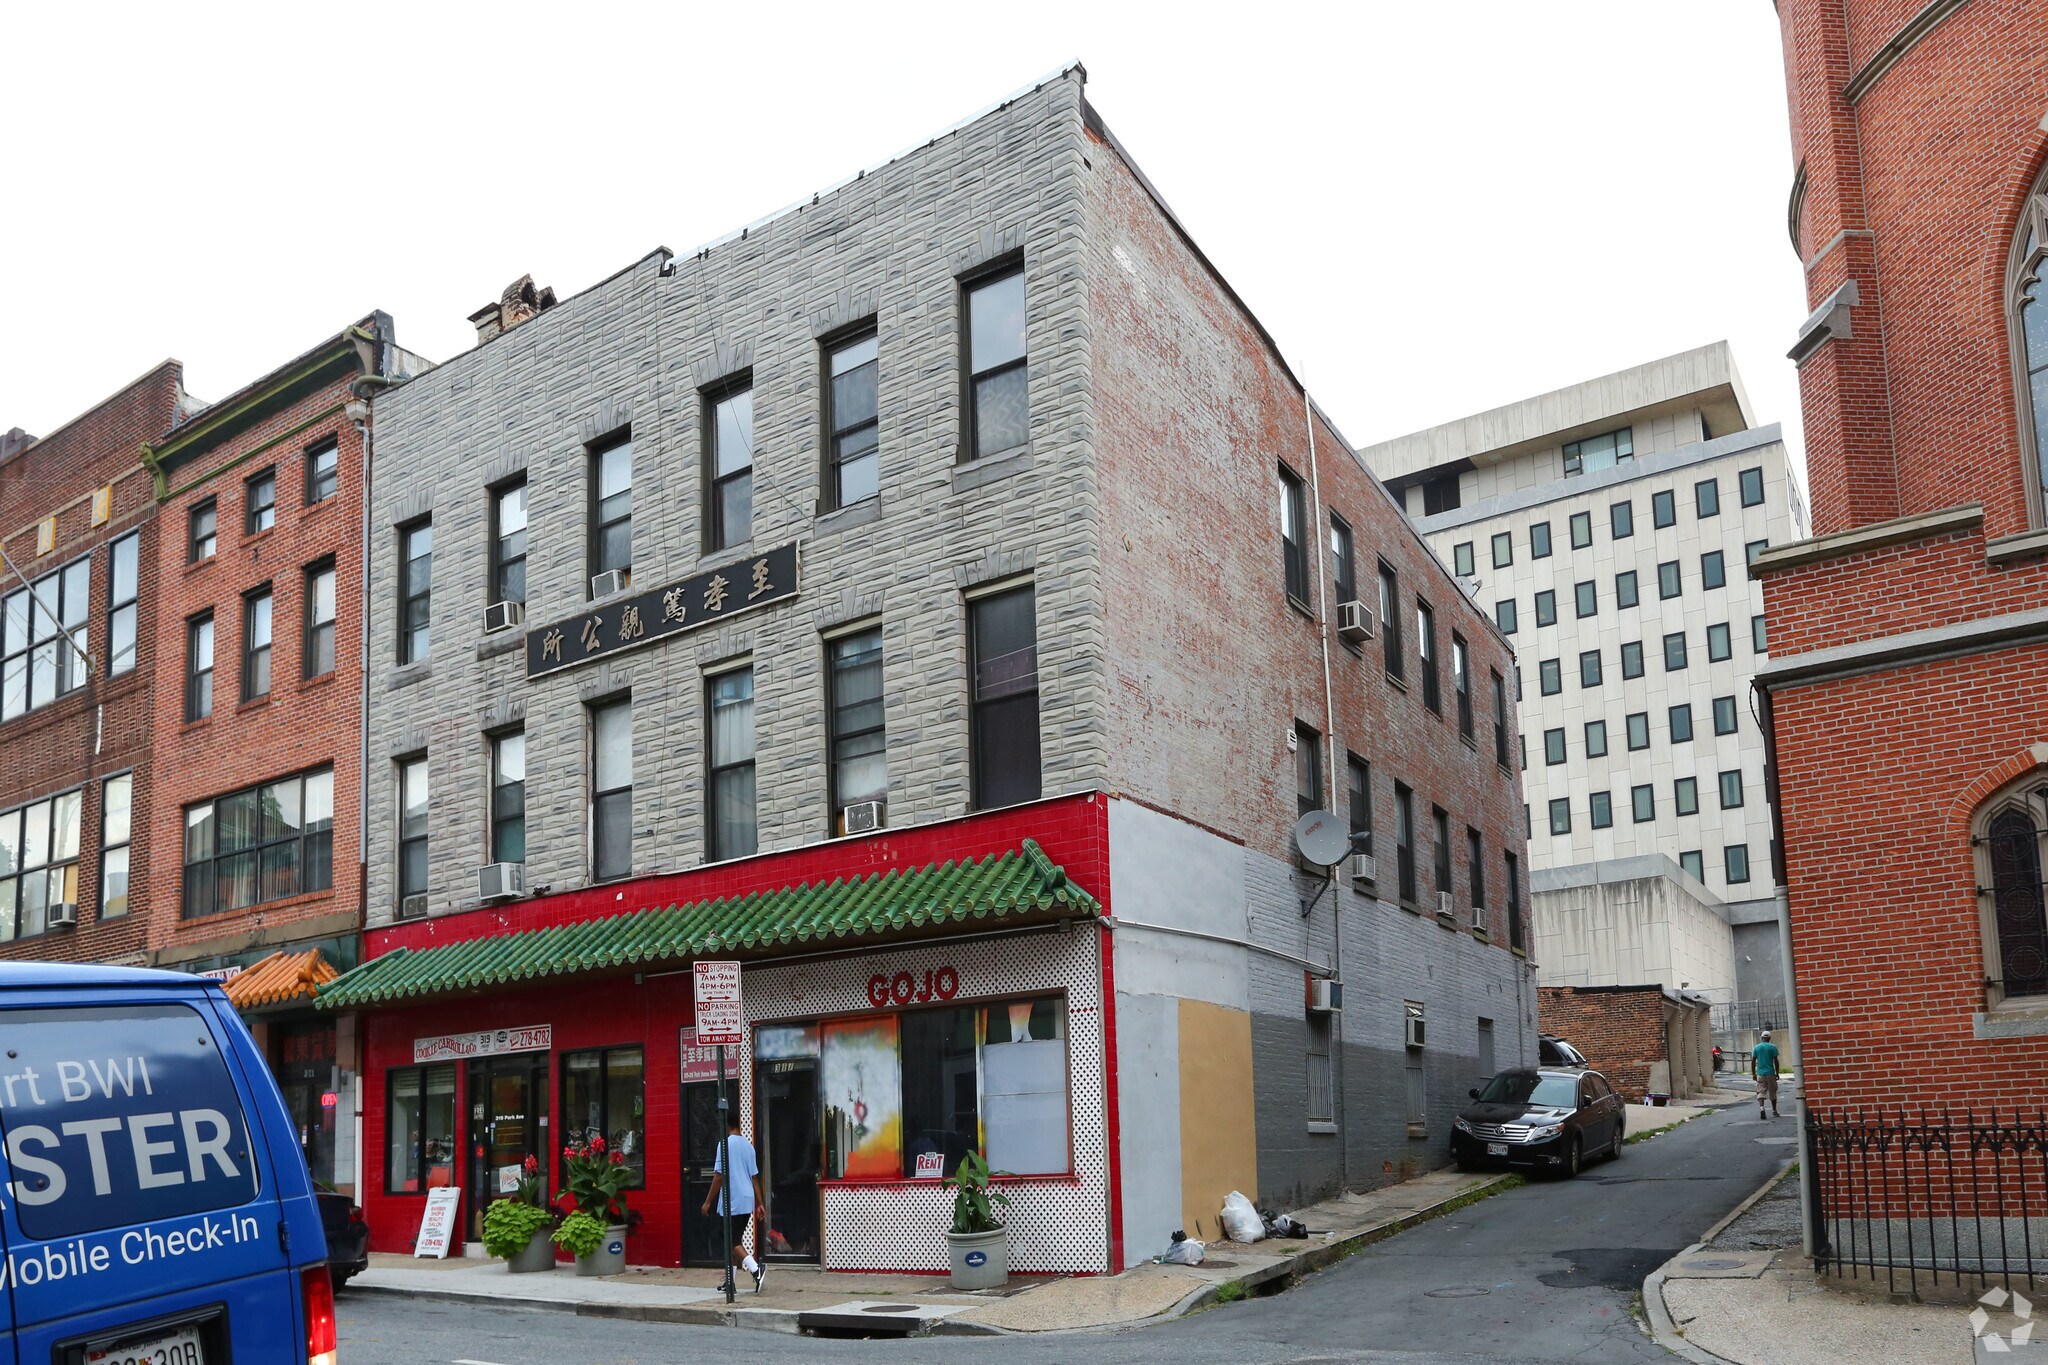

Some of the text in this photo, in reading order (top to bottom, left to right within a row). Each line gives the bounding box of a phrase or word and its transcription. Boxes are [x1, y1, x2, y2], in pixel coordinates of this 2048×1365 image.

[696, 964, 737, 973] NO STOPPING
[699, 973, 736, 981] 7AM-9AM
[699, 982, 737, 990] 4PM-6PM
[867, 965, 959, 1008] GOJO
[697, 1003, 710, 1011] NO
[701, 1018, 738, 1026] 9AM-4PM
[480, 1034, 491, 1044] 319
[520, 1029, 550, 1047] 278-4782
[699, 1035, 711, 1043] TOW
[727, 1034, 741, 1042] ZONE
[416, 1041, 438, 1059] COOKIE
[438, 1037, 466, 1054] CARROLL
[0, 1056, 153, 1108] rt BWI
[321, 1093, 338, 1106] OPEN
[0, 1108, 241, 1211] STER
[120, 1212, 260, 1265] Check-In
